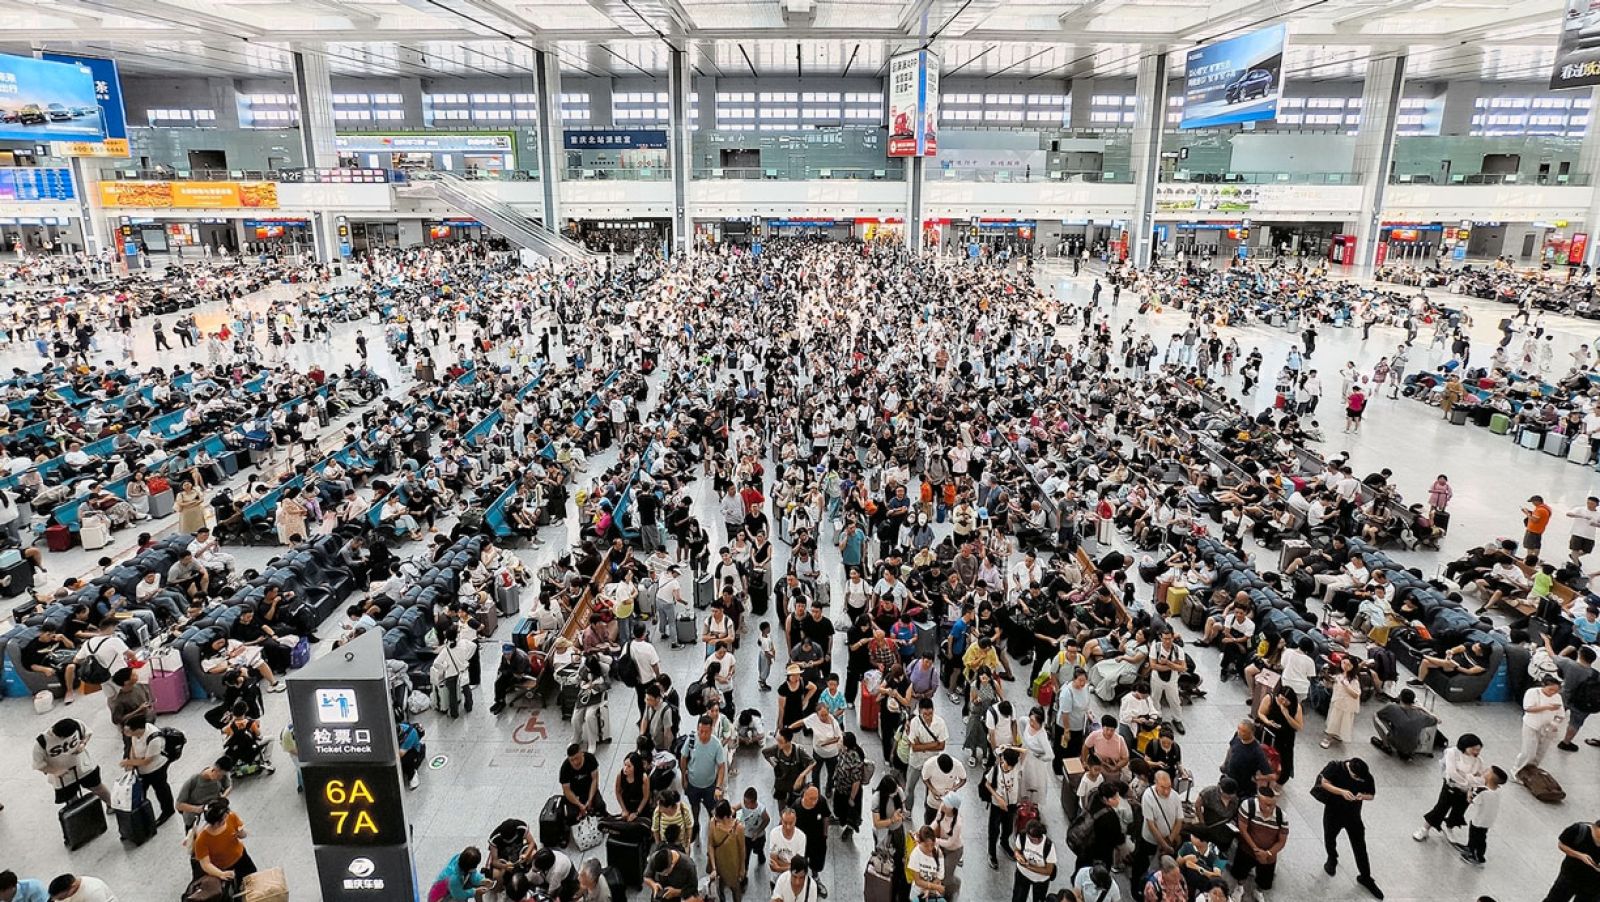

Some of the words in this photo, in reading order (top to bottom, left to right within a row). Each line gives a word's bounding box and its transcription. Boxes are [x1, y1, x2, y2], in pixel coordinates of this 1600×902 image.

[313, 728, 371, 744] 检票口
[315, 745, 342, 753] Ticket
[343, 745, 371, 753] Check
[326, 779, 375, 804] 6A
[330, 811, 379, 834] 7A
